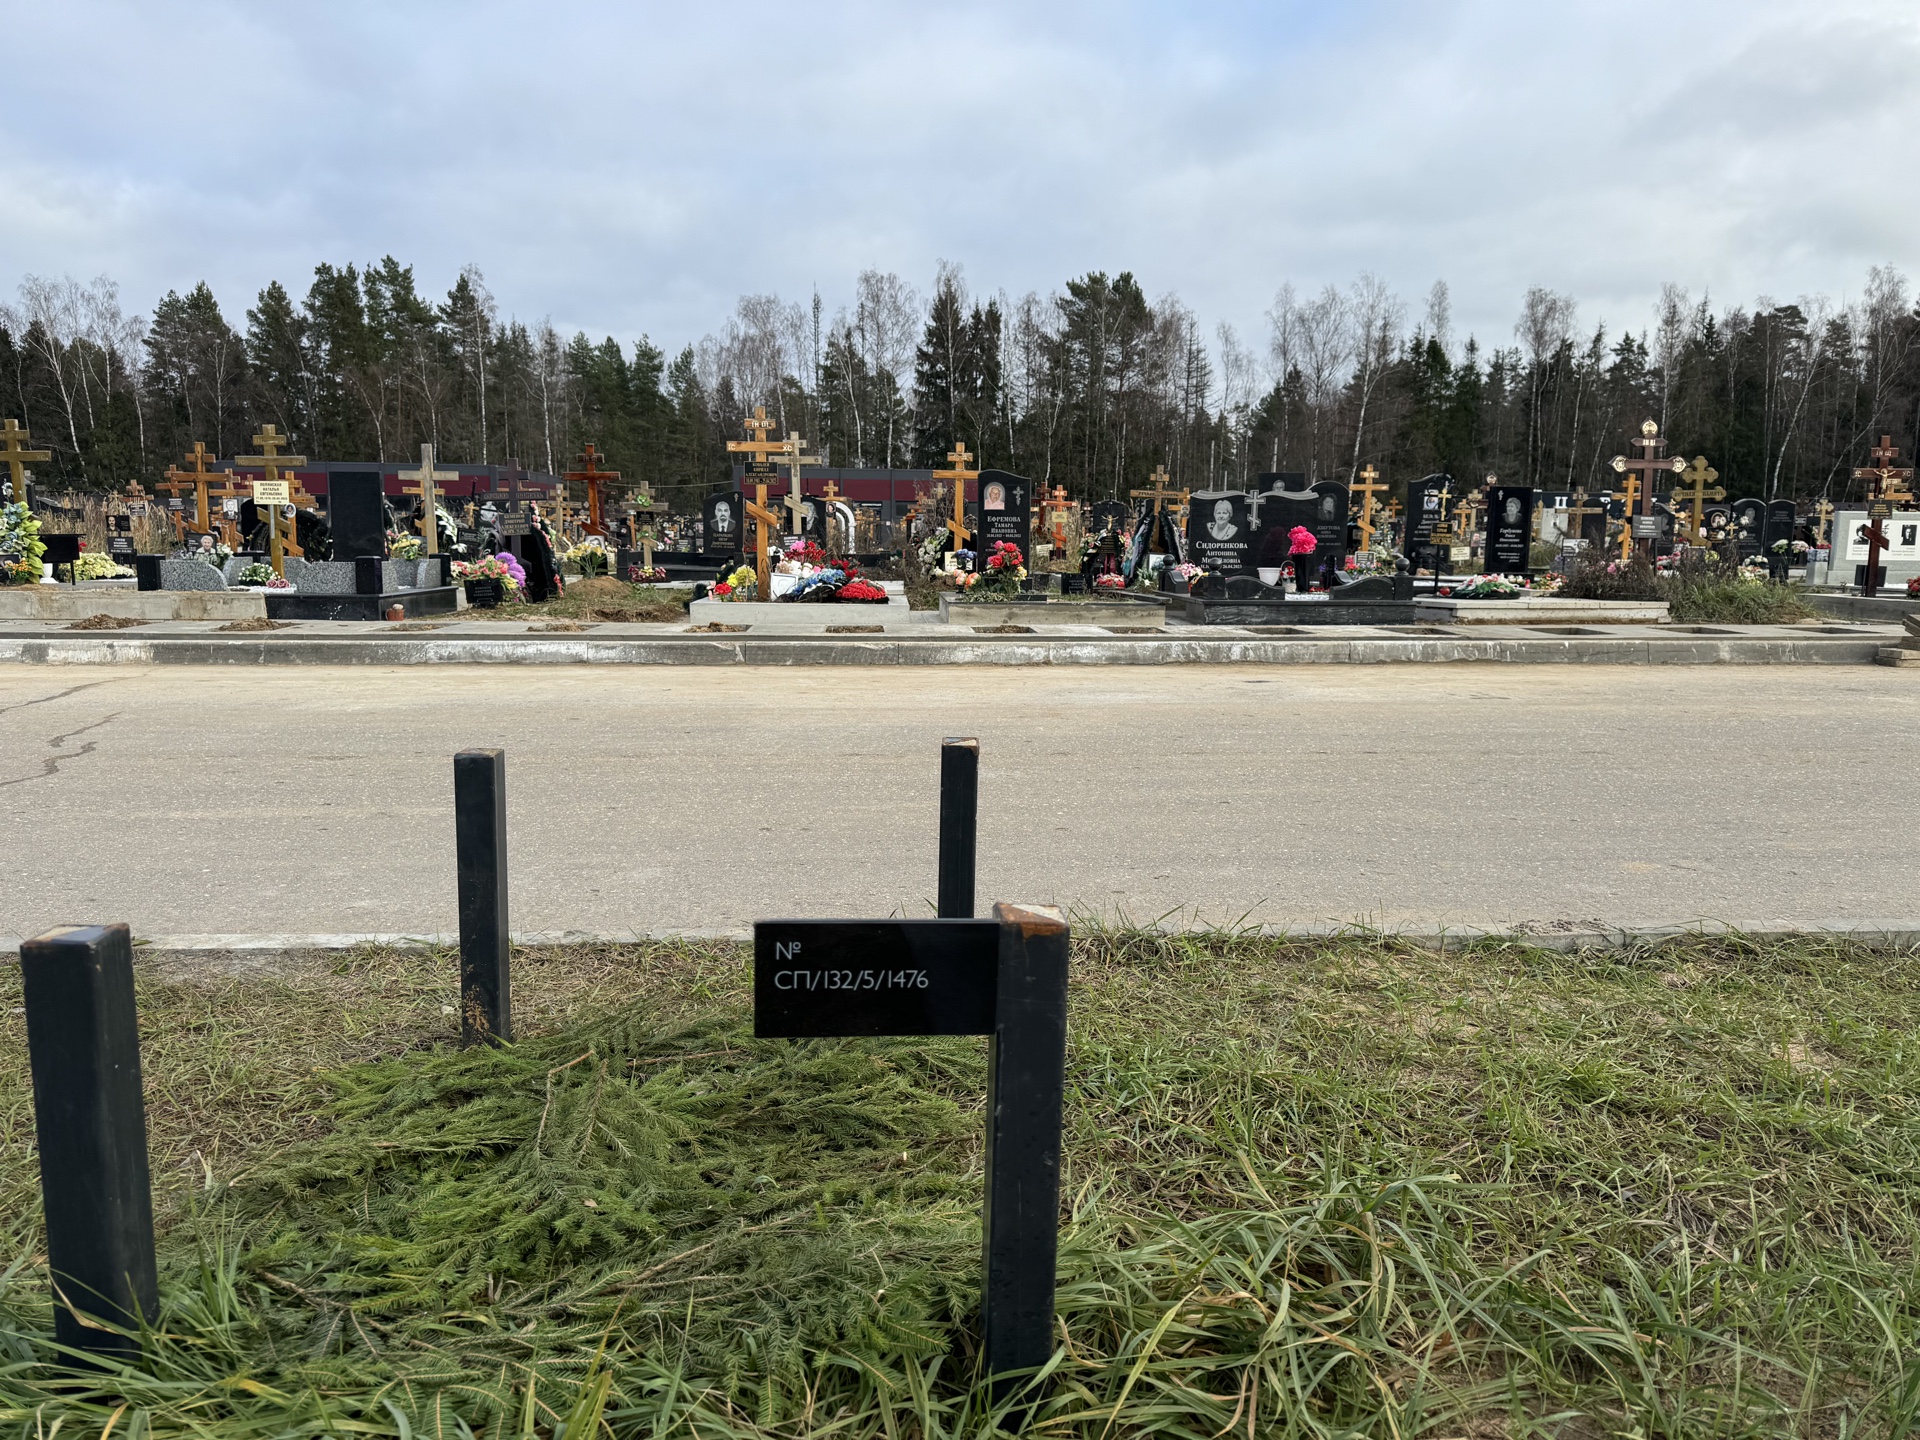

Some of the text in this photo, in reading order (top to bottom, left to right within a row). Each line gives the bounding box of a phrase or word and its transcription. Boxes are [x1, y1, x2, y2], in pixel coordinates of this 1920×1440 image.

[1195, 541, 1248, 549] СИДОРЕНКОВА
[776, 942, 801, 960] №
[774, 970, 929, 991] СП/132/5/1476
